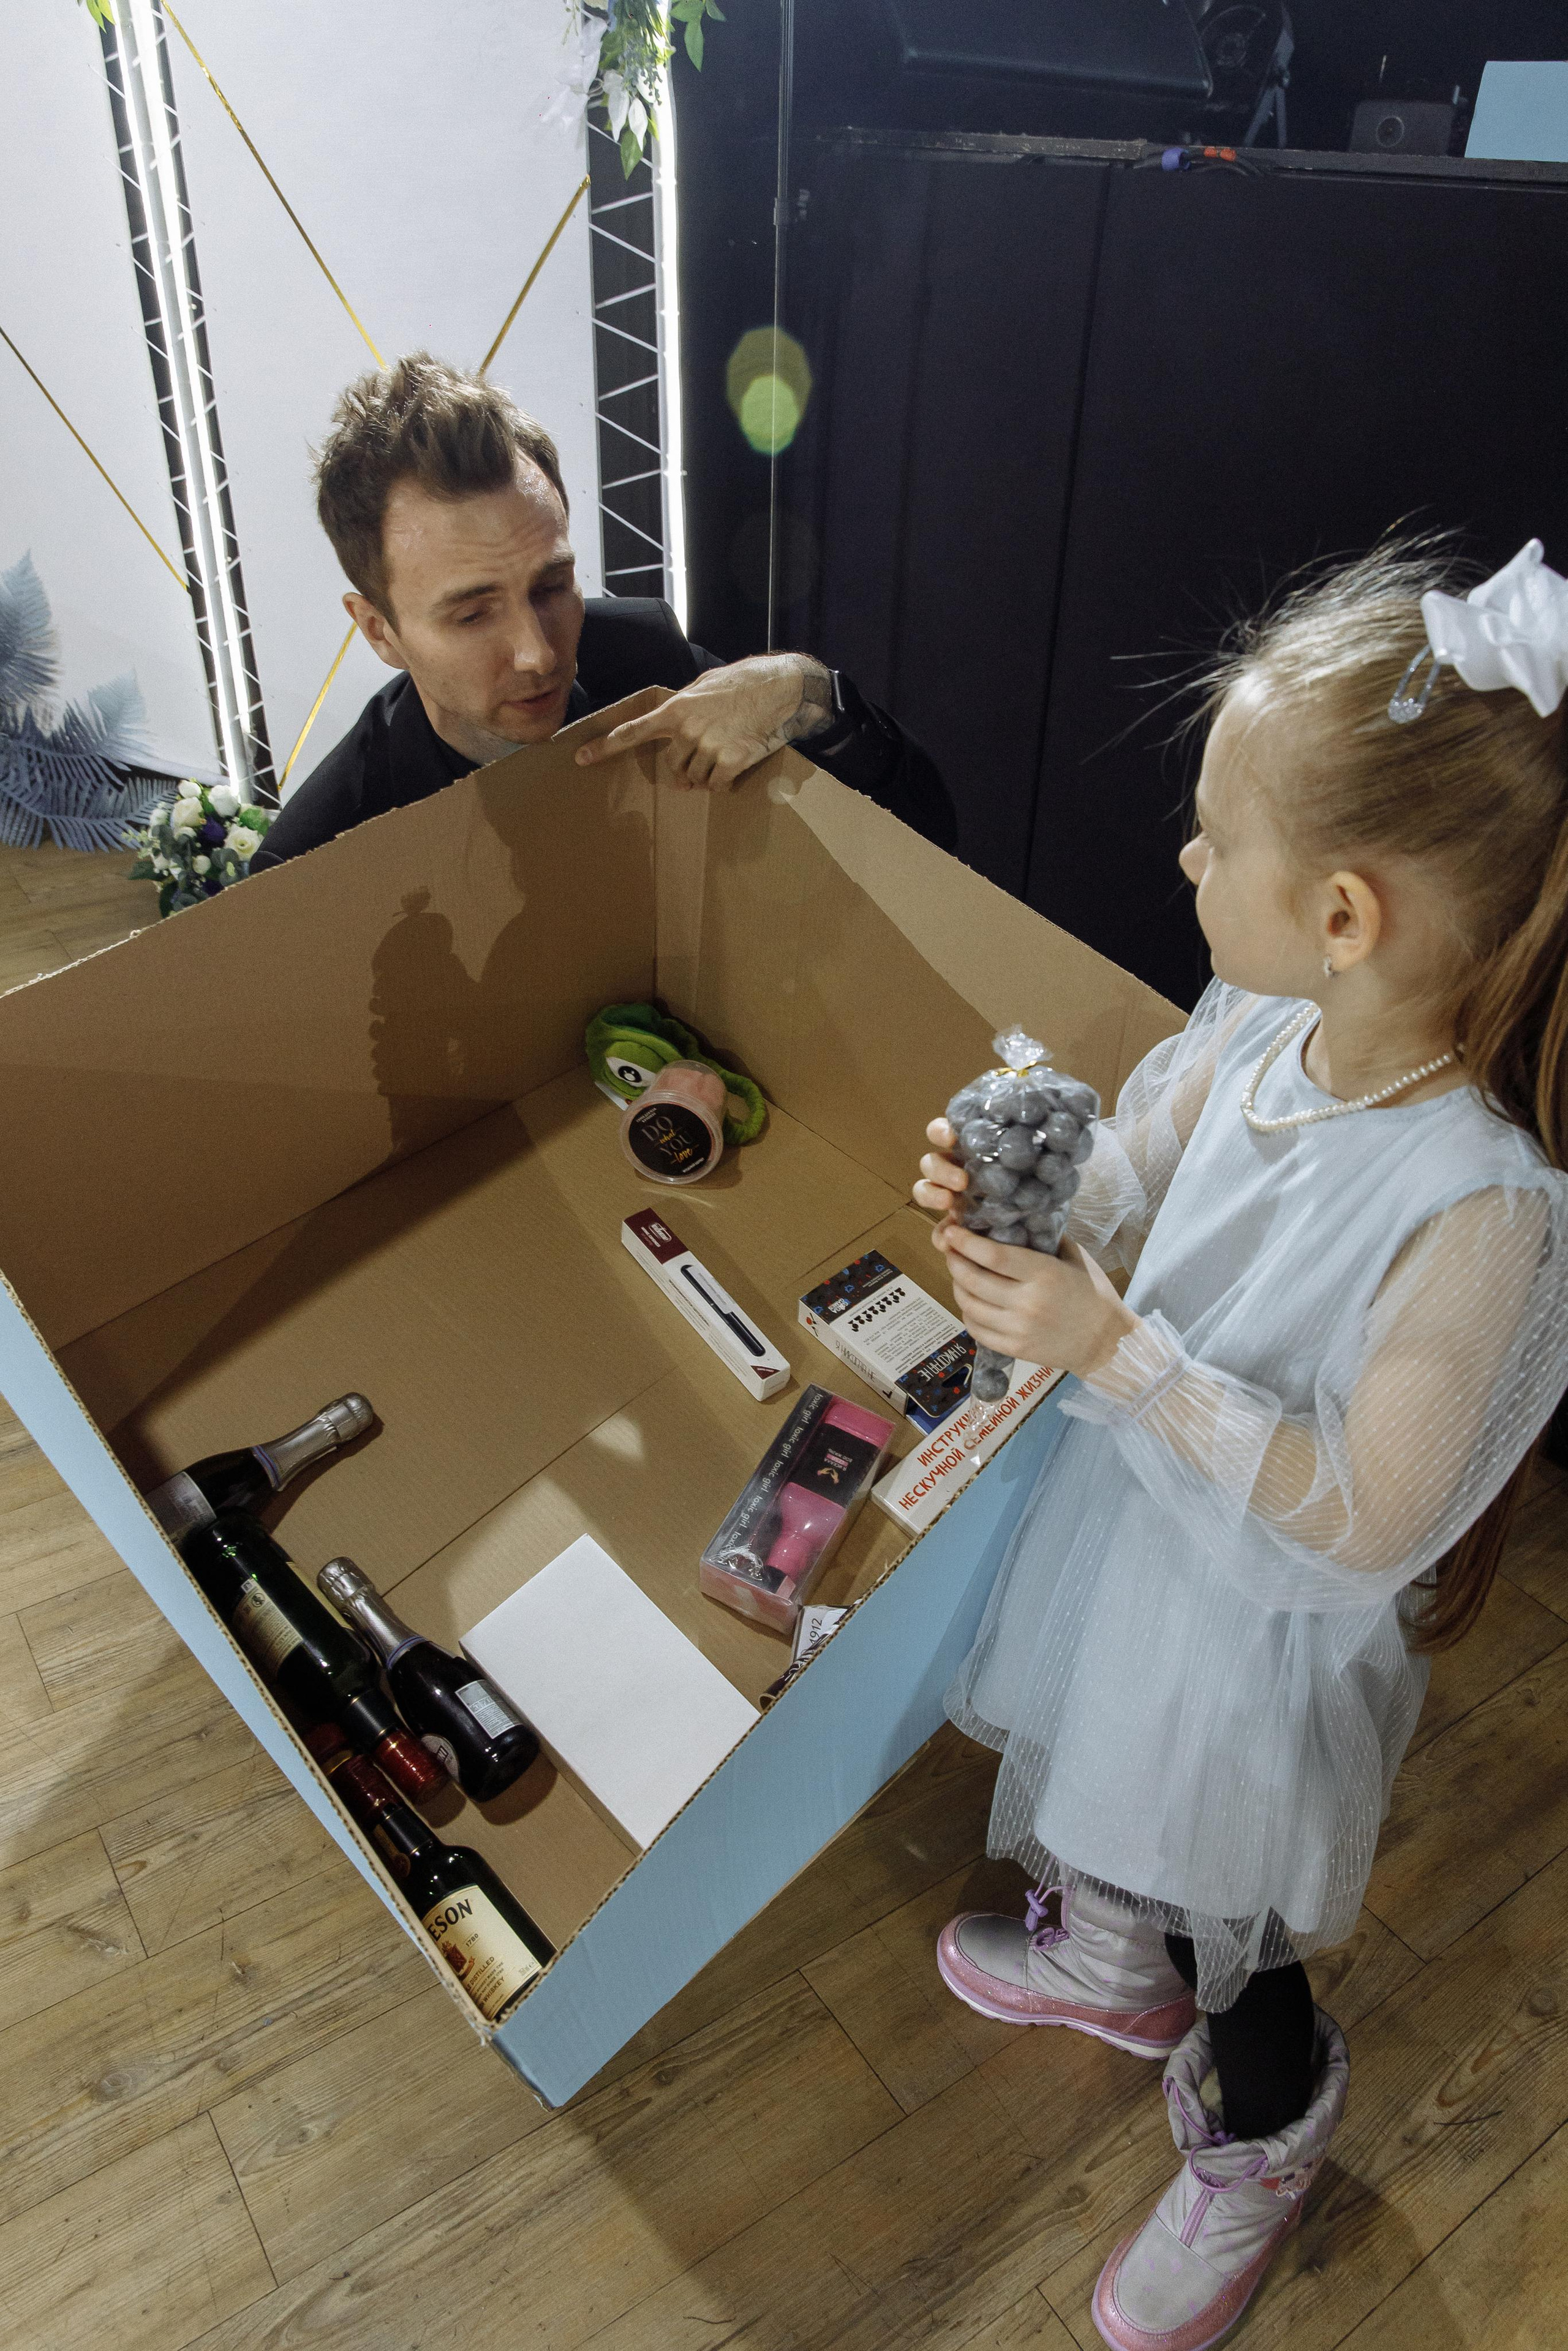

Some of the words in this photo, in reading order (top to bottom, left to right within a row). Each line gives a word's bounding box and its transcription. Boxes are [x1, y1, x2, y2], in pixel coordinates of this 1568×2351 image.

[642, 1116, 673, 1141] DO
[660, 1131, 693, 1155] YOU
[674, 1149, 693, 1163] love
[956, 1343, 967, 1355] Я
[930, 1346, 962, 1375] НИКОГДА
[917, 1365, 934, 1383] НЕ
[808, 1393, 824, 1409] toxic
[799, 1409, 812, 1424] girl
[788, 1426, 804, 1444] toxic
[899, 1447, 965, 1510] НЕСКУЧНОЙ
[963, 1396, 1020, 1450] СЕМЕЙНОЙ
[1016, 1367, 1054, 1401] ЖИЗНИ
[779, 1443, 792, 1458] girl
[769, 1460, 784, 1477] toxic
[759, 1477, 772, 1492] girl
[747, 1495, 763, 1513] toxic
[737, 1512, 751, 1528] girl
[428, 1898, 473, 1942] ESON
[466, 1933, 479, 1948] 1780
[470, 1957, 495, 1987] DISTILLED
[484, 1976, 505, 2002] WHISKEY
